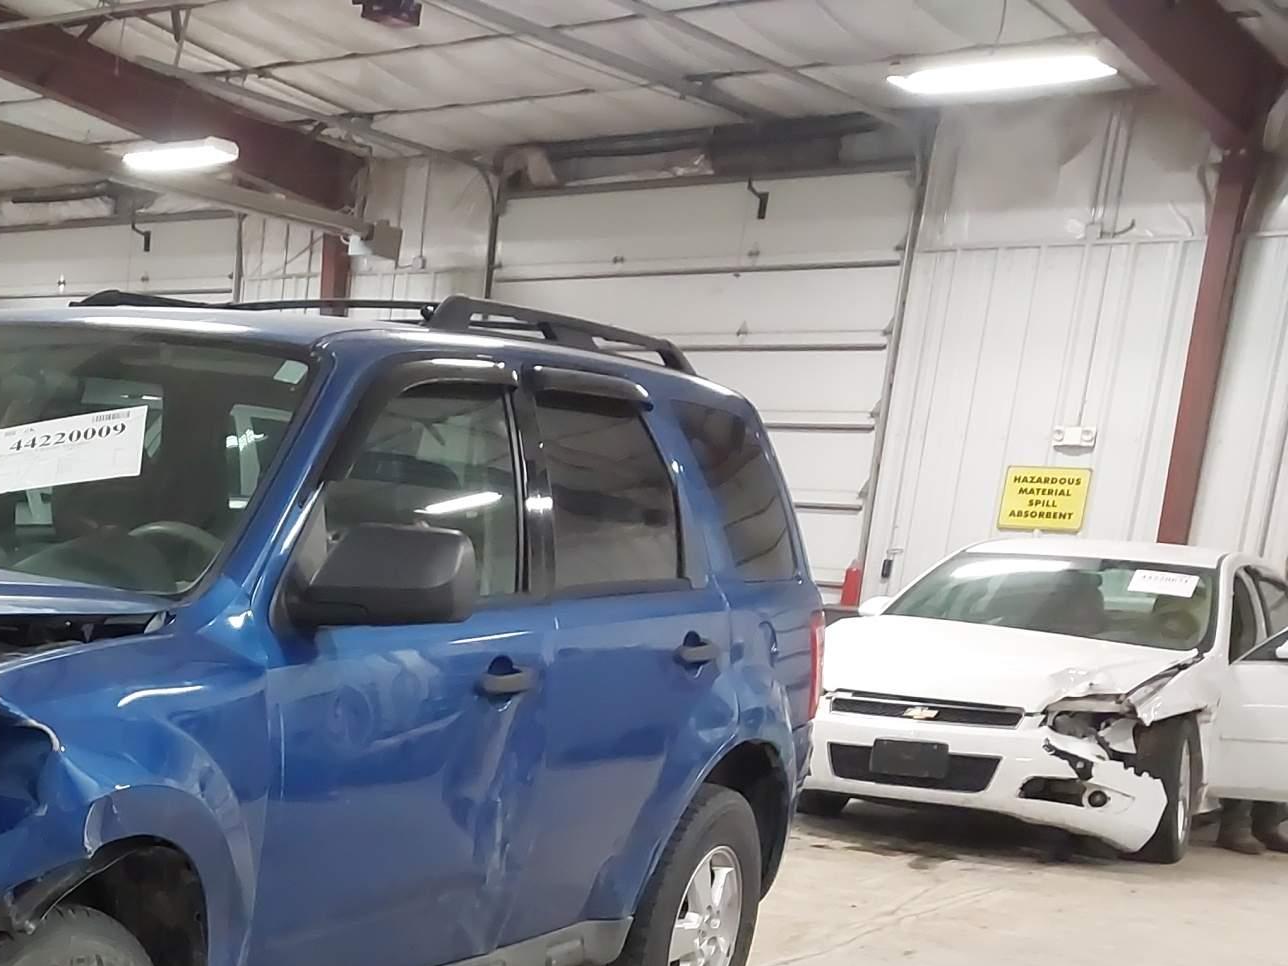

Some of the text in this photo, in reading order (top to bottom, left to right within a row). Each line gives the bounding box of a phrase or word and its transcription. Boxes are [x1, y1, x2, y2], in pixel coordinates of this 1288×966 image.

[9, 422, 127, 451] 44220009
[1013, 475, 1082, 486] HAZARDOUS
[1018, 487, 1071, 497] MATERIAL
[1028, 498, 1057, 508] SPILL
[1008, 509, 1074, 520] ABSORBENT
